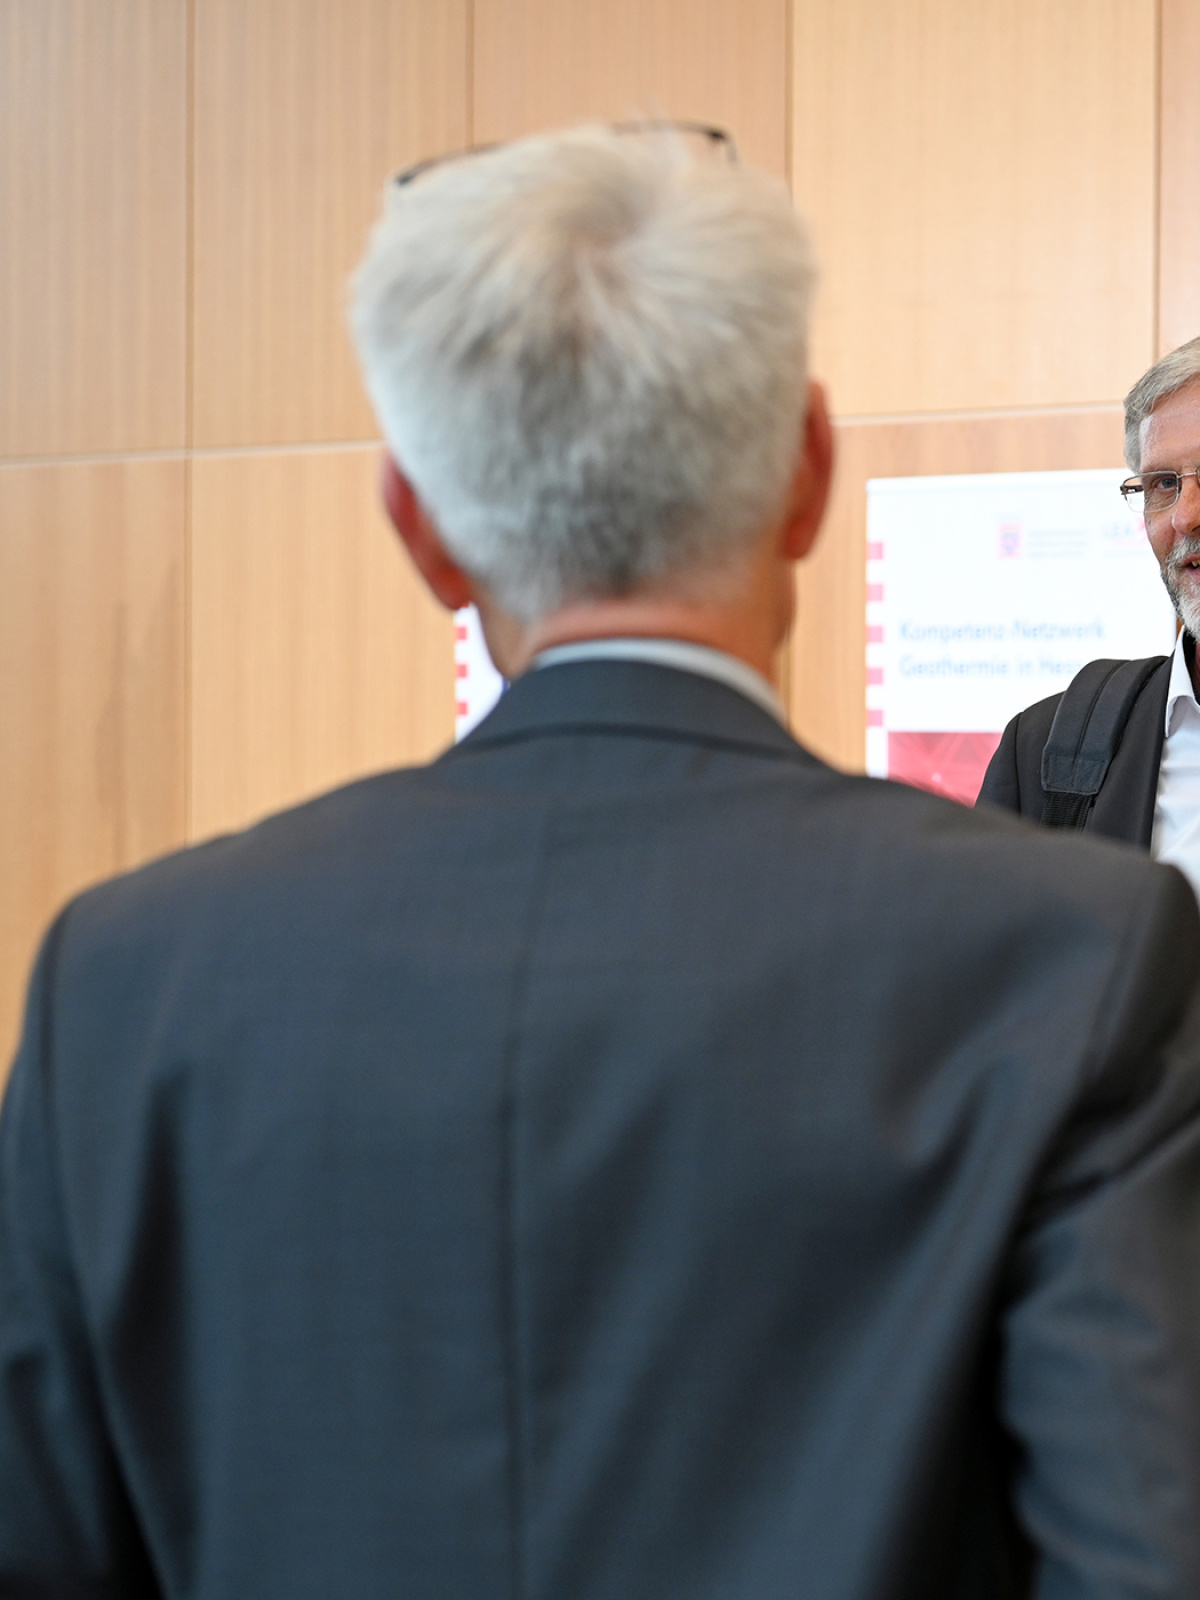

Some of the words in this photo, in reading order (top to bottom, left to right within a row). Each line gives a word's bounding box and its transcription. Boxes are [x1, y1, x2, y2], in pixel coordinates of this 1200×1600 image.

[900, 618, 1104, 643] Kompetenz-Netzwerk
[900, 655, 1009, 677] Geothermie
[1018, 655, 1034, 676] in
